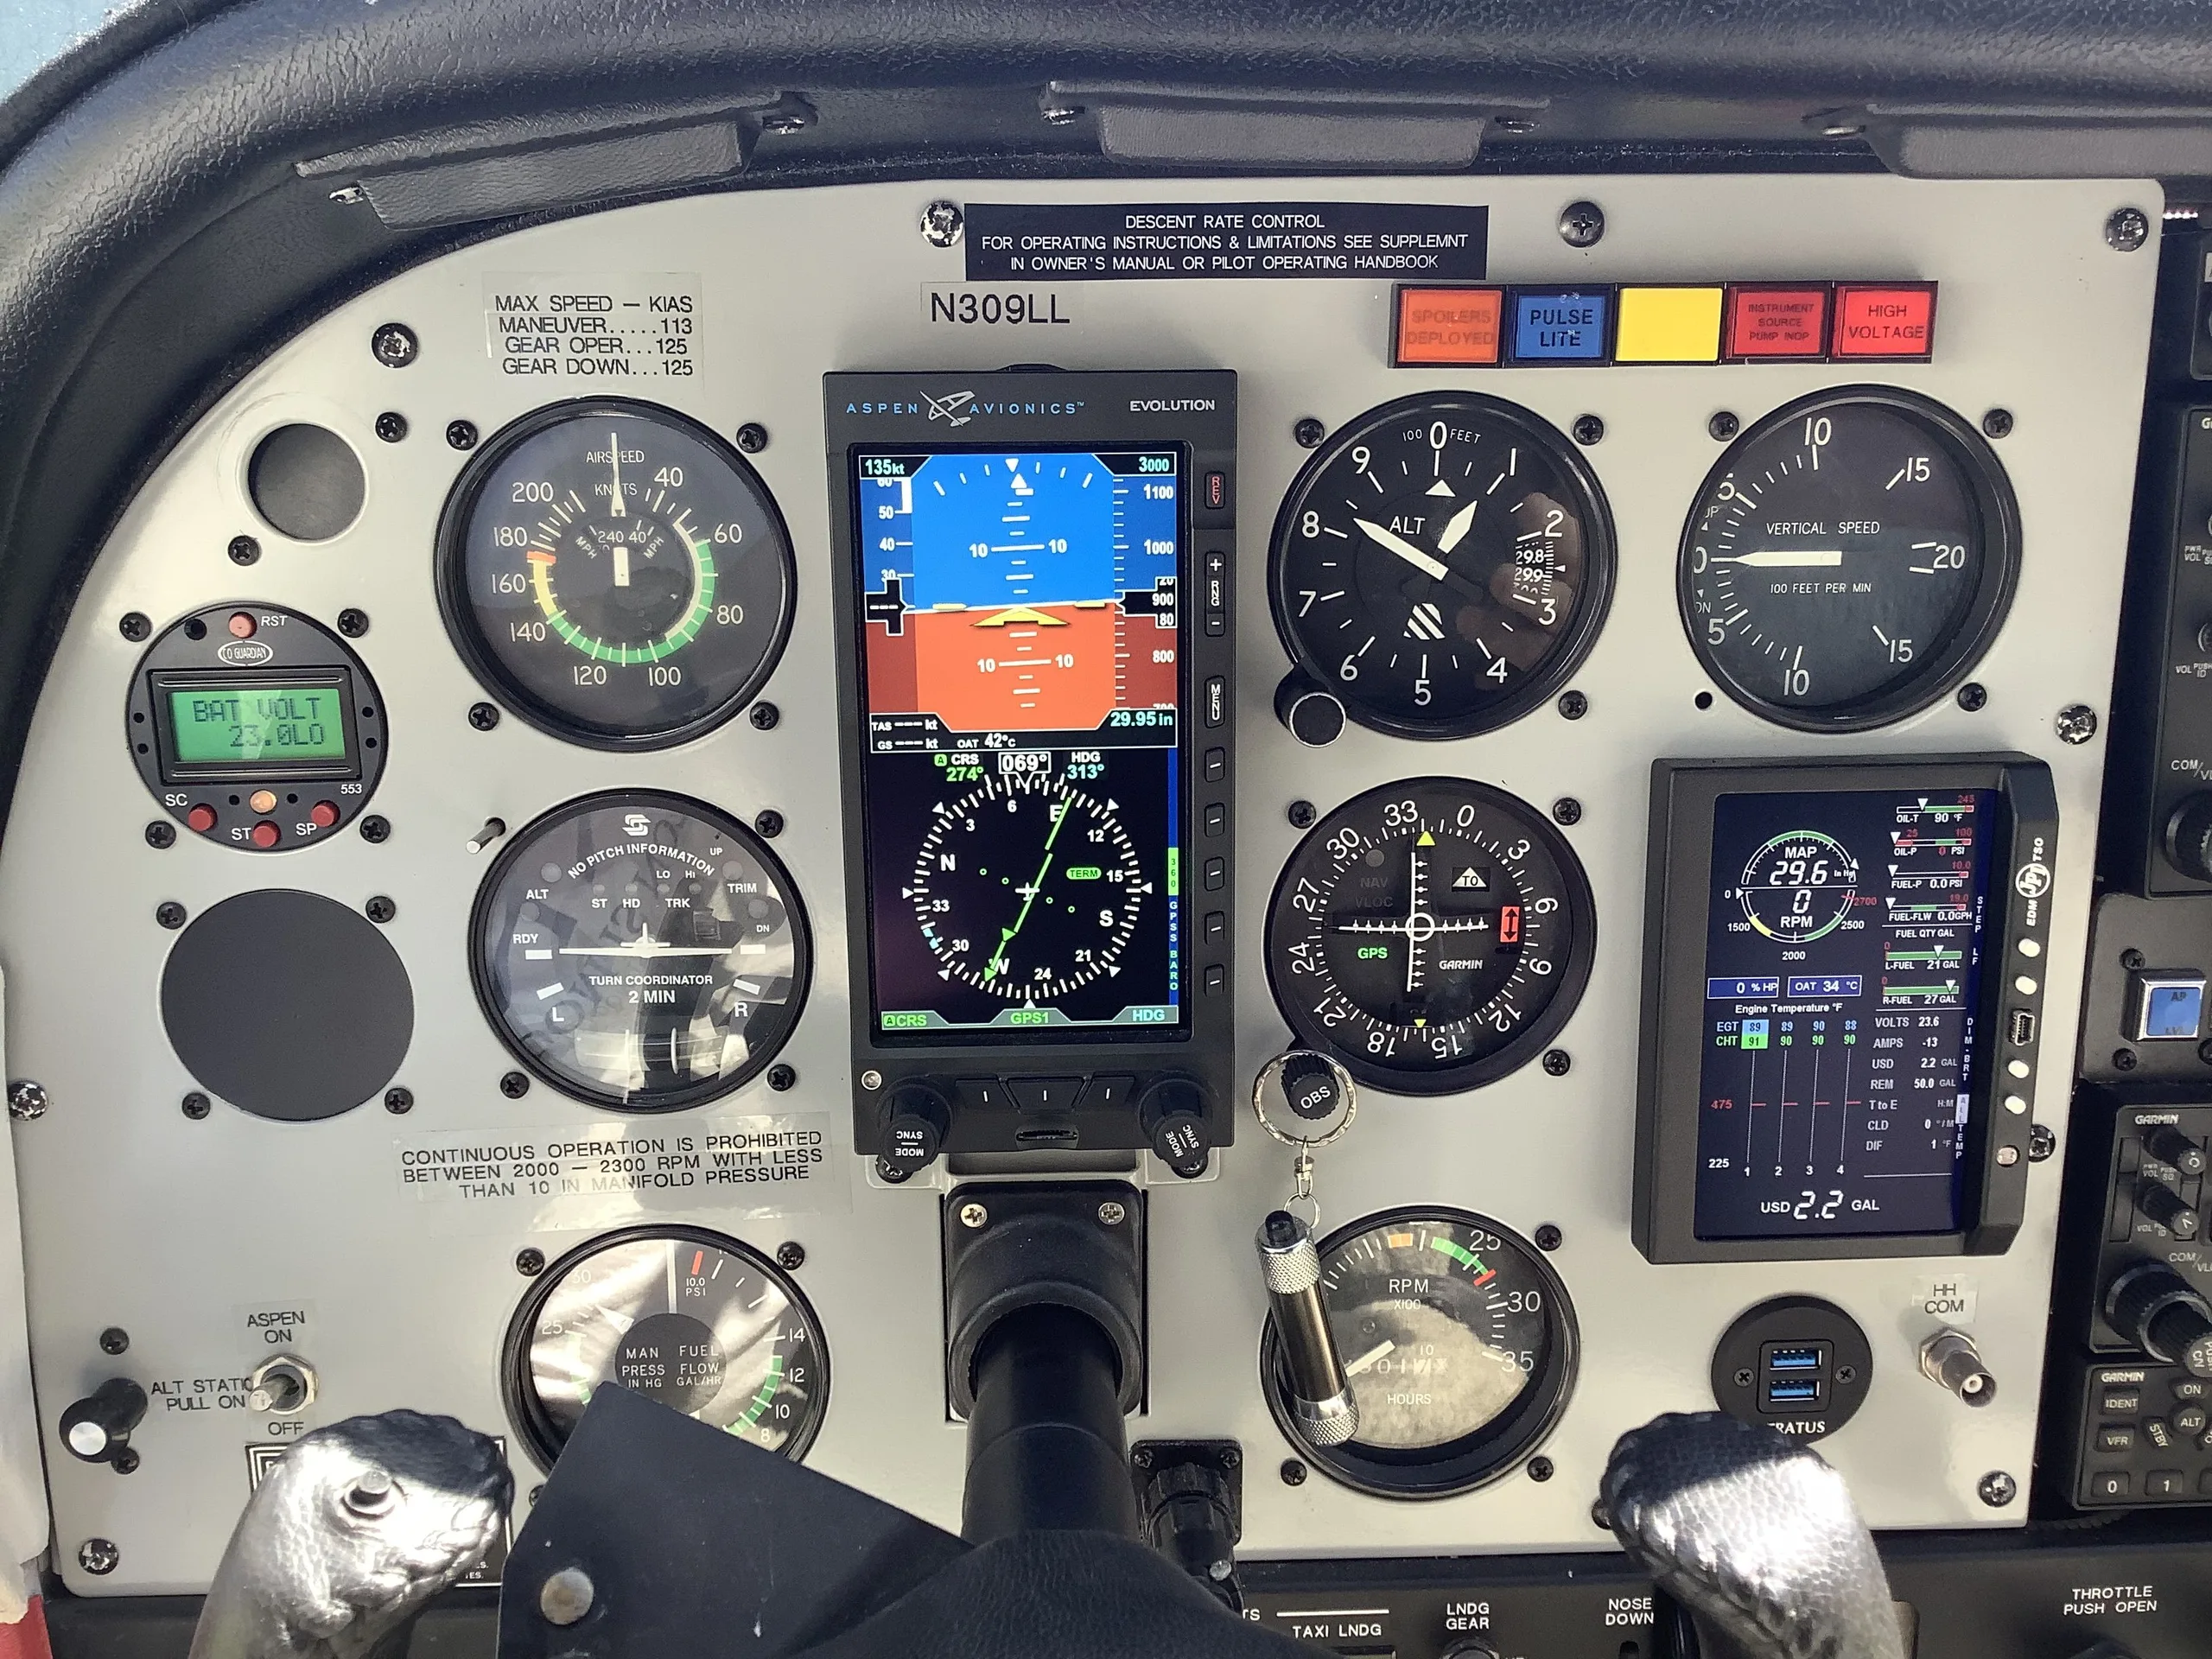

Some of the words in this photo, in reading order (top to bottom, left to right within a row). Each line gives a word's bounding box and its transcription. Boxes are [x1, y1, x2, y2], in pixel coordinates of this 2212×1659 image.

[1125, 215, 1196, 229] DESCENT
[1204, 214, 1243, 229] RATE
[1252, 214, 1325, 229] CONTROL
[982, 236, 1013, 250] FOR
[1020, 236, 1106, 250] OPERATING
[1113, 235, 1222, 250] INSTRUCTIONS
[1230, 236, 1239, 249] &
[1248, 235, 1336, 250] LIMITATIONS
[1343, 235, 1372, 249] SEE
[1380, 234, 1468, 249] SUPPLEMNT
[1011, 257, 1024, 270] IN
[1031, 257, 1105, 270] OWNER'S
[1112, 257, 1175, 270] MANUAL
[1182, 257, 1205, 270] OR
[1212, 256, 1255, 270] PILOT
[1262, 256, 1347, 270] OPERATING
[1354, 255, 1439, 269] HANDBOOK
[495, 296, 537, 312] MAX
[550, 296, 613, 312] SPEED
[649, 296, 692, 313] KIAS
[931, 292, 1070, 324] N309LL
[1747, 303, 1815, 313] INSTRUMENT
[1867, 304, 1907, 318] HIGH
[1411, 309, 1491, 324] SPOILERS
[1530, 308, 1593, 325] PULSE
[1758, 318, 1802, 327] SOURCE
[1406, 331, 1494, 345] DEPLOYED
[1540, 331, 1581, 346] LITE
[1749, 332, 1779, 340] PUMP
[1783, 331, 1810, 340] INOP
[1848, 326, 1924, 339] VOLTAGE
[505, 337, 560, 353] GEAR
[502, 359, 556, 375] GEAR
[846, 403, 918, 415] ASPEN
[1129, 399, 1216, 412] EVOLUTION
[1402, 429, 1422, 442] 100
[1449, 428, 1481, 444] FEET
[865, 459, 905, 475] 135kt
[1139, 456, 1169, 473] 3000
[654, 467, 683, 487] 40
[512, 481, 553, 502] 200
[1143, 484, 1173, 499] 1100
[1211, 476, 1220, 505] REV
[715, 523, 742, 543] 60
[1389, 517, 1426, 535] ALT
[1766, 522, 1827, 535] VERTICAL
[1838, 521, 1880, 534] SPEED
[1211, 581, 1220, 607] RNG
[1770, 583, 1787, 594] 100
[1792, 583, 1820, 594] FEET
[1825, 583, 1847, 594] PER
[1853, 582, 1872, 593] MIN
[261, 615, 288, 627] RST
[716, 605, 743, 625] 80
[1152, 650, 1174, 663] 800
[1211, 683, 1221, 721] MENU
[193, 700, 239, 722] BAT
[257, 697, 320, 721] VOLT
[1110, 712, 1156, 728] 29.95
[957, 739, 979, 748] OAT
[950, 753, 979, 766] CRS
[1071, 751, 1101, 763] HDG
[340, 784, 362, 795] 553
[165, 793, 188, 807] SC
[1383, 800, 1419, 827] 33
[231, 827, 251, 841] ST
[296, 823, 317, 836] SP
[1784, 846, 1817, 859] MAP
[568, 862, 587, 880] NO
[586, 845, 624, 867] PITCH
[626, 843, 715, 877] INFORMATION
[656, 870, 671, 879] LO
[1070, 868, 1098, 878] TERM
[1770, 861, 1828, 886] 29.6
[727, 883, 757, 893] TRIM
[1462, 875, 1478, 887] TO
[525, 889, 550, 899] ALT
[591, 899, 608, 908] ST
[622, 899, 641, 908] HD
[665, 898, 690, 908] TRK
[1780, 916, 1813, 928] RPM
[512, 934, 539, 944] RDY
[1357, 947, 1388, 960] GPS
[1439, 960, 1484, 970] GARMIN
[588, 976, 622, 986] TURN
[625, 976, 713, 986] COORDINATOR
[1795, 982, 1817, 991] OAT
[643, 990, 676, 1003] MIN
[1132, 1008, 1165, 1022] HDG
[1735, 1005, 1768, 1015] Engine
[1771, 1003, 1829, 1015] Temperature
[1010, 1011, 1049, 1025] GPS1
[1875, 1017, 1910, 1027] VOLTS
[1918, 1016, 1940, 1027] 23.6
[1872, 1038, 1904, 1048] AMPS
[1300, 1085, 1331, 1109] OBS
[2135, 1114, 2180, 1125] GARMIN
[896, 1130, 923, 1140] SYNC
[402, 1145, 535, 1166] CONTINUOUS
[548, 1139, 664, 1158] OPERATION
[677, 1137, 693, 1152] IS
[706, 1131, 822, 1150] PROHIBITED
[895, 1147, 924, 1157] MODE
[404, 1165, 501, 1183] BETWEEN
[513, 1163, 559, 1178] 2000
[600, 1158, 645, 1173] 2300
[658, 1154, 700, 1170] RPM
[713, 1152, 762, 1166] WITH
[773, 1148, 823, 1164] LESS
[459, 1182, 515, 1198] THAN
[530, 1180, 550, 1195] 10
[562, 1178, 580, 1193] IN
[592, 1172, 694, 1192] MANIFOLD
[706, 1166, 810, 1185] PRESSURE
[1760, 1201, 1790, 1213] USD
[1793, 1190, 1843, 1220] 2.2
[1851, 1199, 1879, 1211] GAL
[1389, 1279, 1428, 1294] RPM
[1933, 1283, 1956, 1296] HH
[1508, 1291, 1541, 1313] 30
[1924, 1299, 1964, 1314] COM
[247, 1311, 305, 1327] ASPEN
[264, 1329, 292, 1344] ON
[626, 1347, 658, 1359] MAN
[679, 1344, 719, 1357] FUEL
[1501, 1351, 1534, 1372] 35
[622, 1364, 665, 1376] PRESS
[680, 1363, 719, 1375] FLOW
[2101, 1371, 2145, 1382] GARMIN
[151, 1381, 183, 1395] ALT
[167, 1396, 210, 1411] PULL
[219, 1395, 245, 1409] ON
[1387, 1393, 1432, 1405] HOURS
[2106, 1399, 2139, 1408] IDENT
[268, 1421, 304, 1435] OFF
[2107, 1436, 2129, 1446] VFR
[2072, 1586, 2153, 1600] THROTTLE
[1446, 1602, 1490, 1616] LNDG
[1608, 1598, 1652, 1611] NOSE
[2063, 1603, 2105, 1616] PUSH
[2115, 1600, 2158, 1613] OPEN
[1446, 1617, 1490, 1630] GEAR
[1605, 1611, 1654, 1626] DOWN
[1292, 1625, 1329, 1639] TAXI
[1338, 1624, 1382, 1638] LNDG
